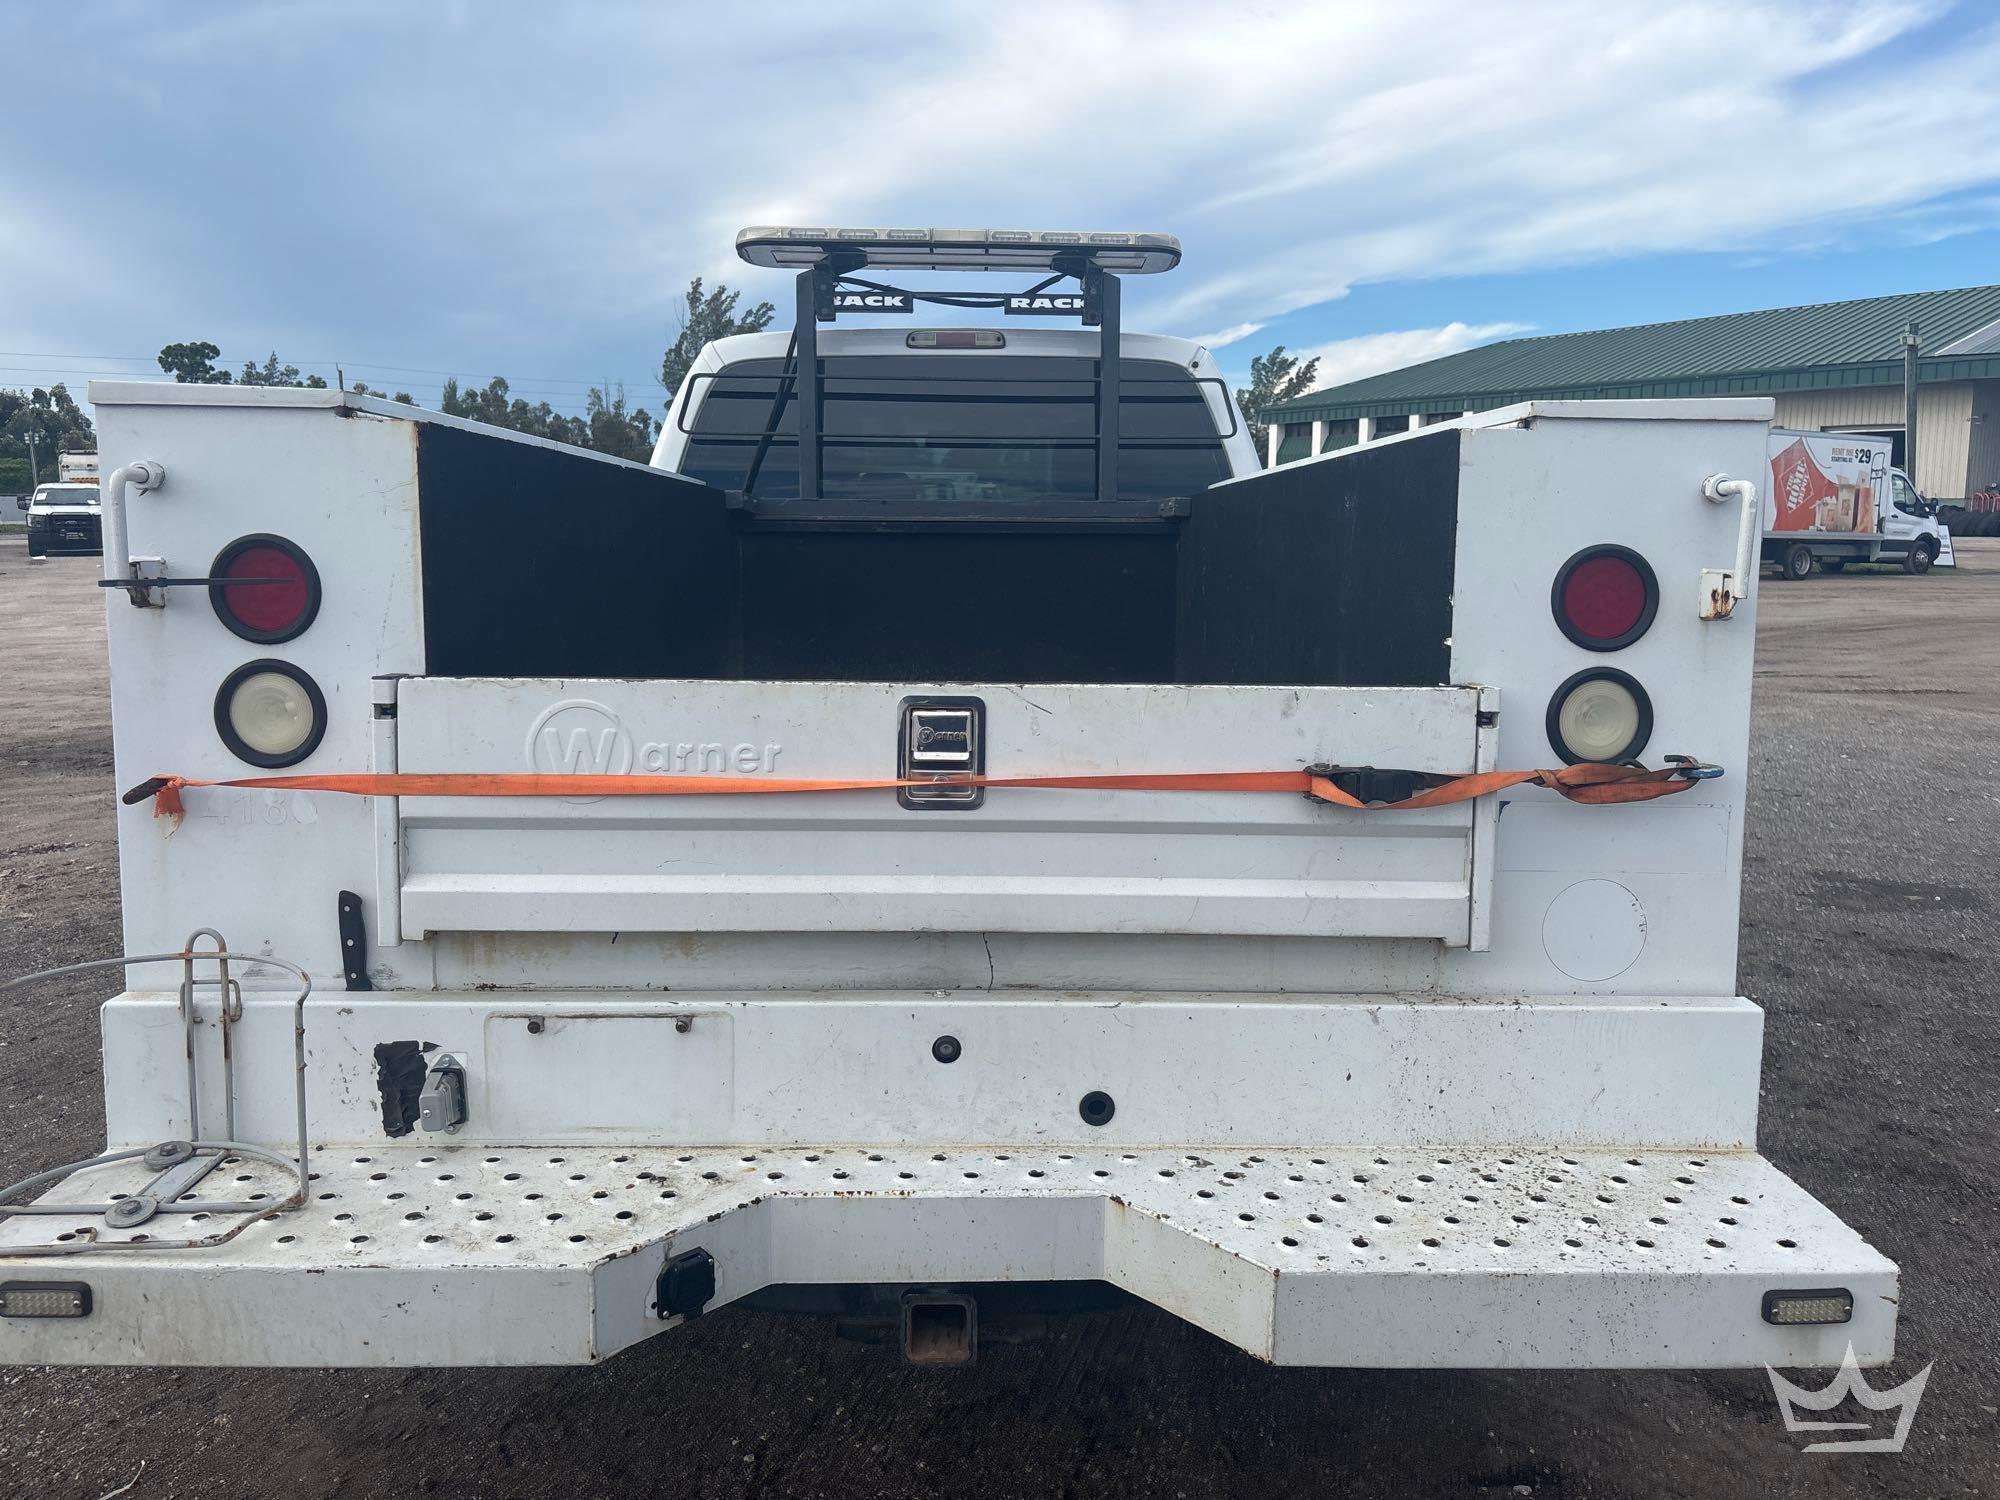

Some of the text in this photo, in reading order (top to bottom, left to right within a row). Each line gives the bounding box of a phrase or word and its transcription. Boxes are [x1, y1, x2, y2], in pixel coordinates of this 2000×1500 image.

[1010, 297, 1085, 309] RACK
[1854, 448, 1872, 464] $29
[1787, 463, 1807, 510] HOME
[543, 727, 783, 774] Warner
